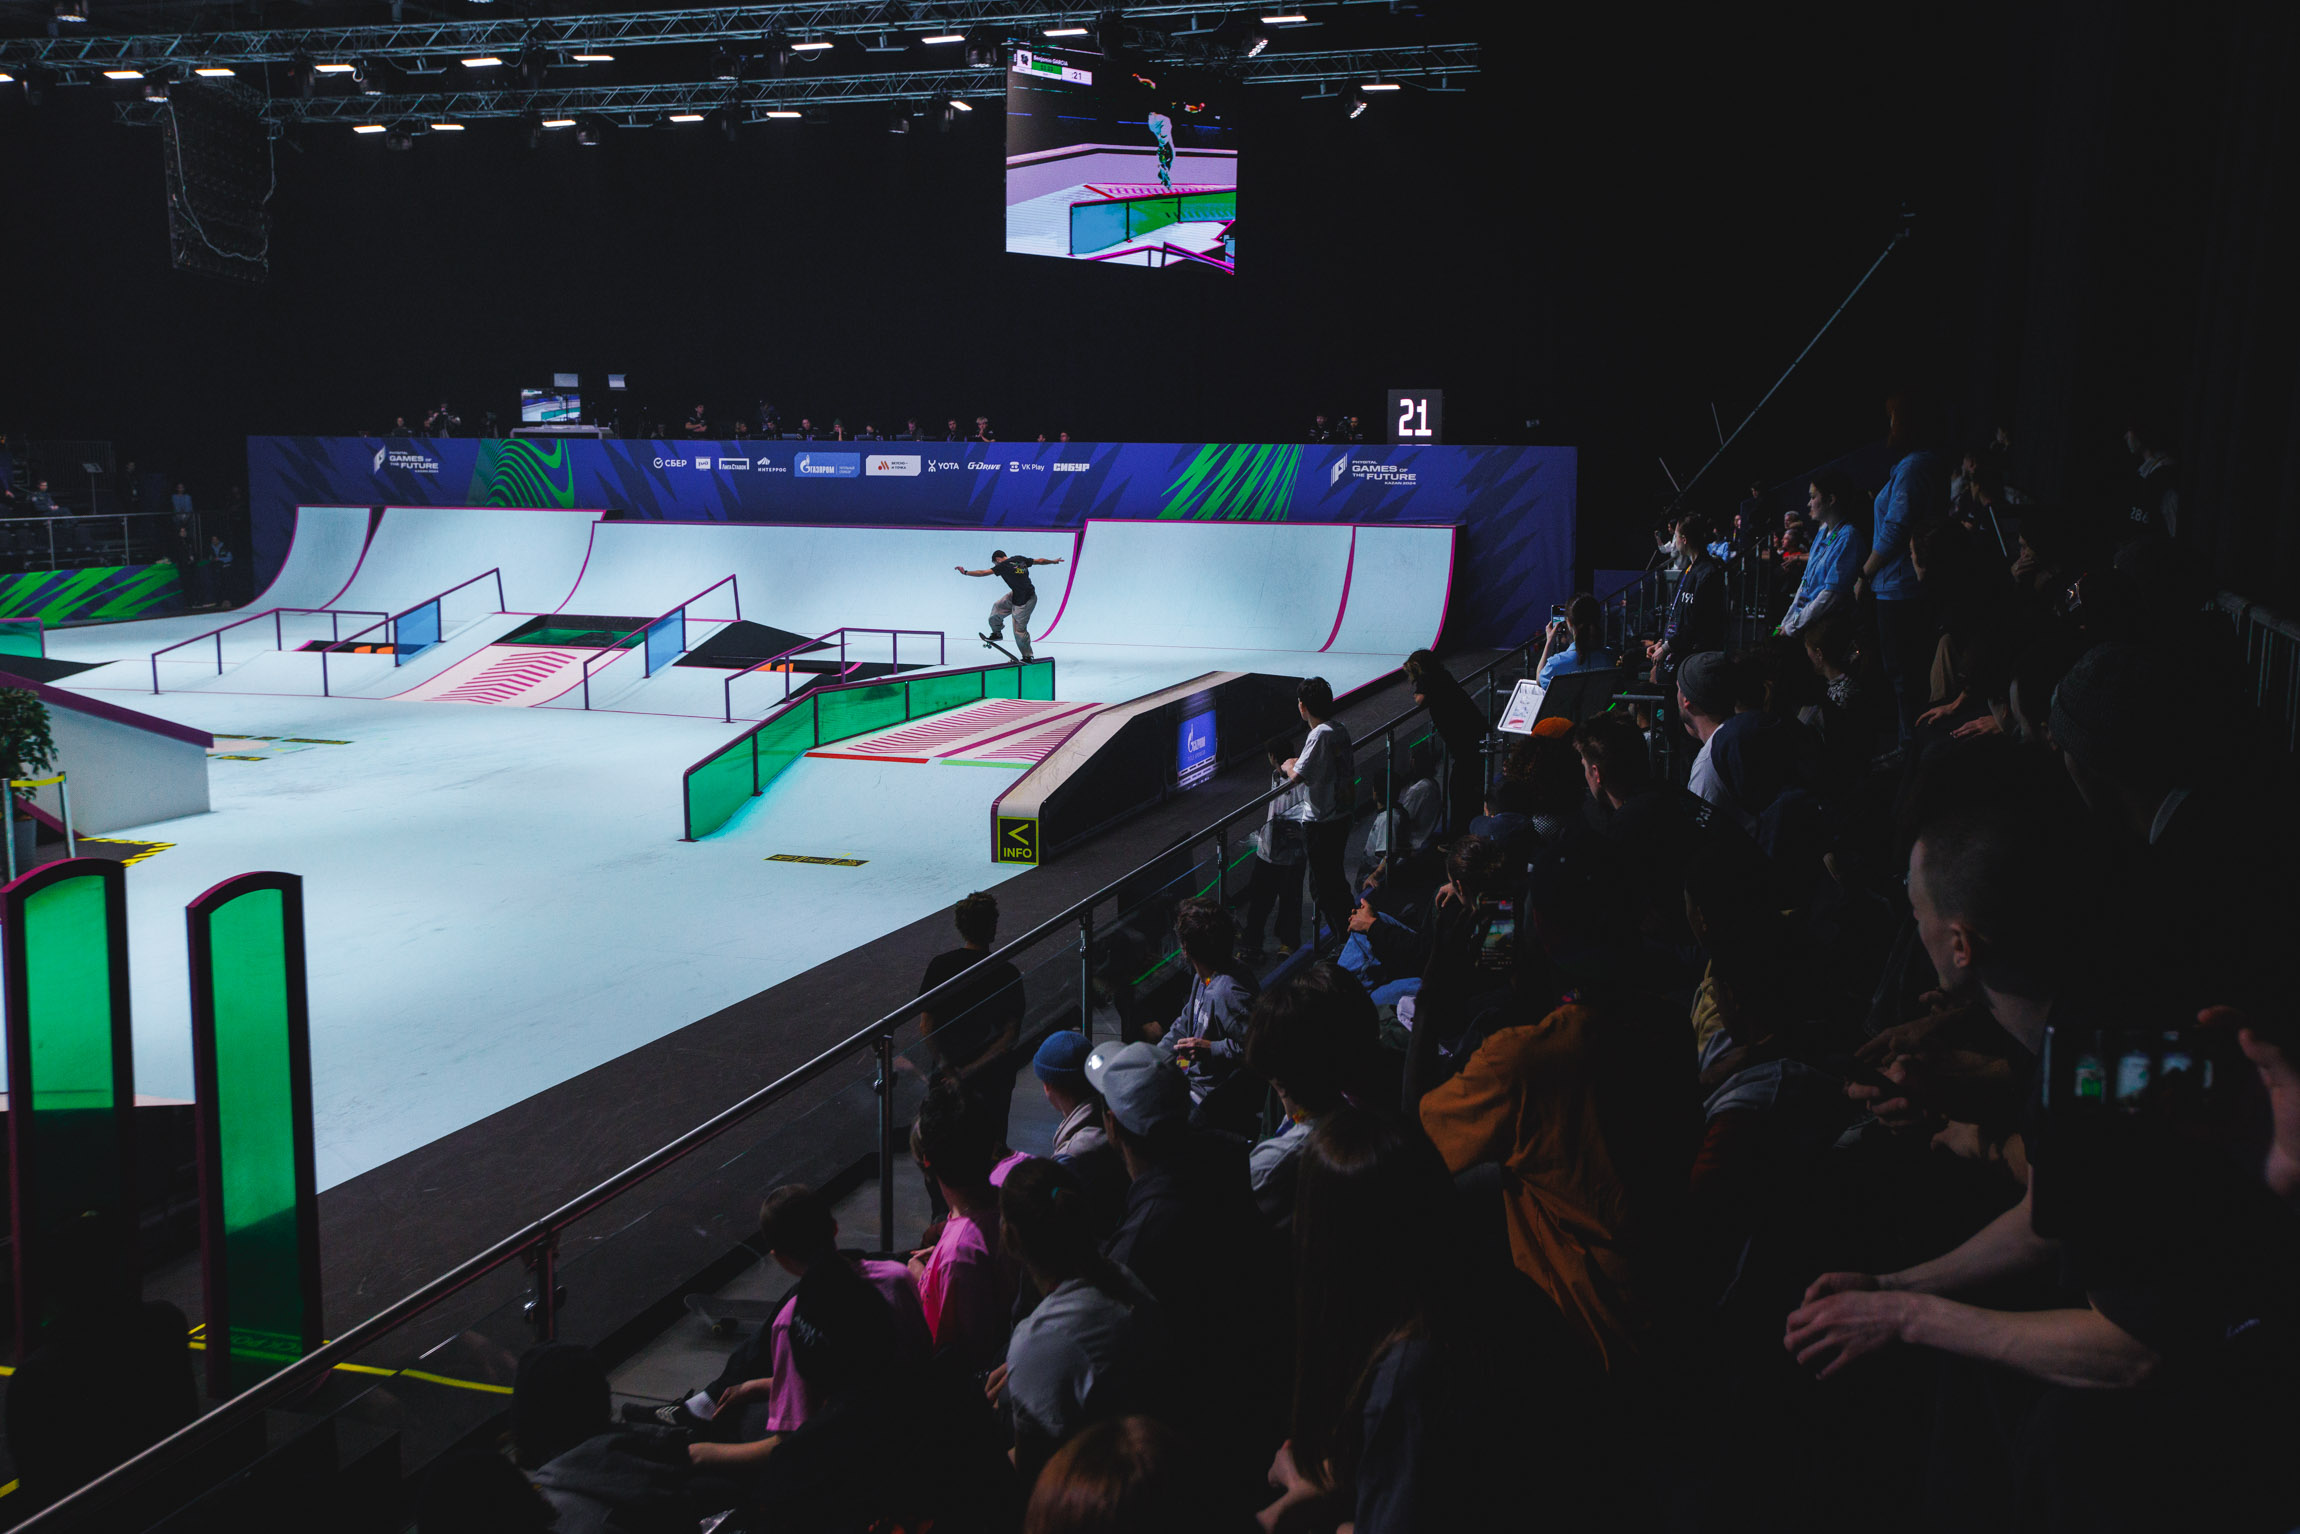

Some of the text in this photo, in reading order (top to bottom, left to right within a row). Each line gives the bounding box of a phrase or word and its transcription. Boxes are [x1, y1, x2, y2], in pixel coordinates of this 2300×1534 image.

[1399, 398, 1432, 436] 21
[664, 459, 688, 468] СБЕР
[937, 462, 960, 470] YOTA
[1031, 463, 1045, 472] Play
[1053, 463, 1090, 472] СИБУР
[1003, 847, 1033, 859] INFO
